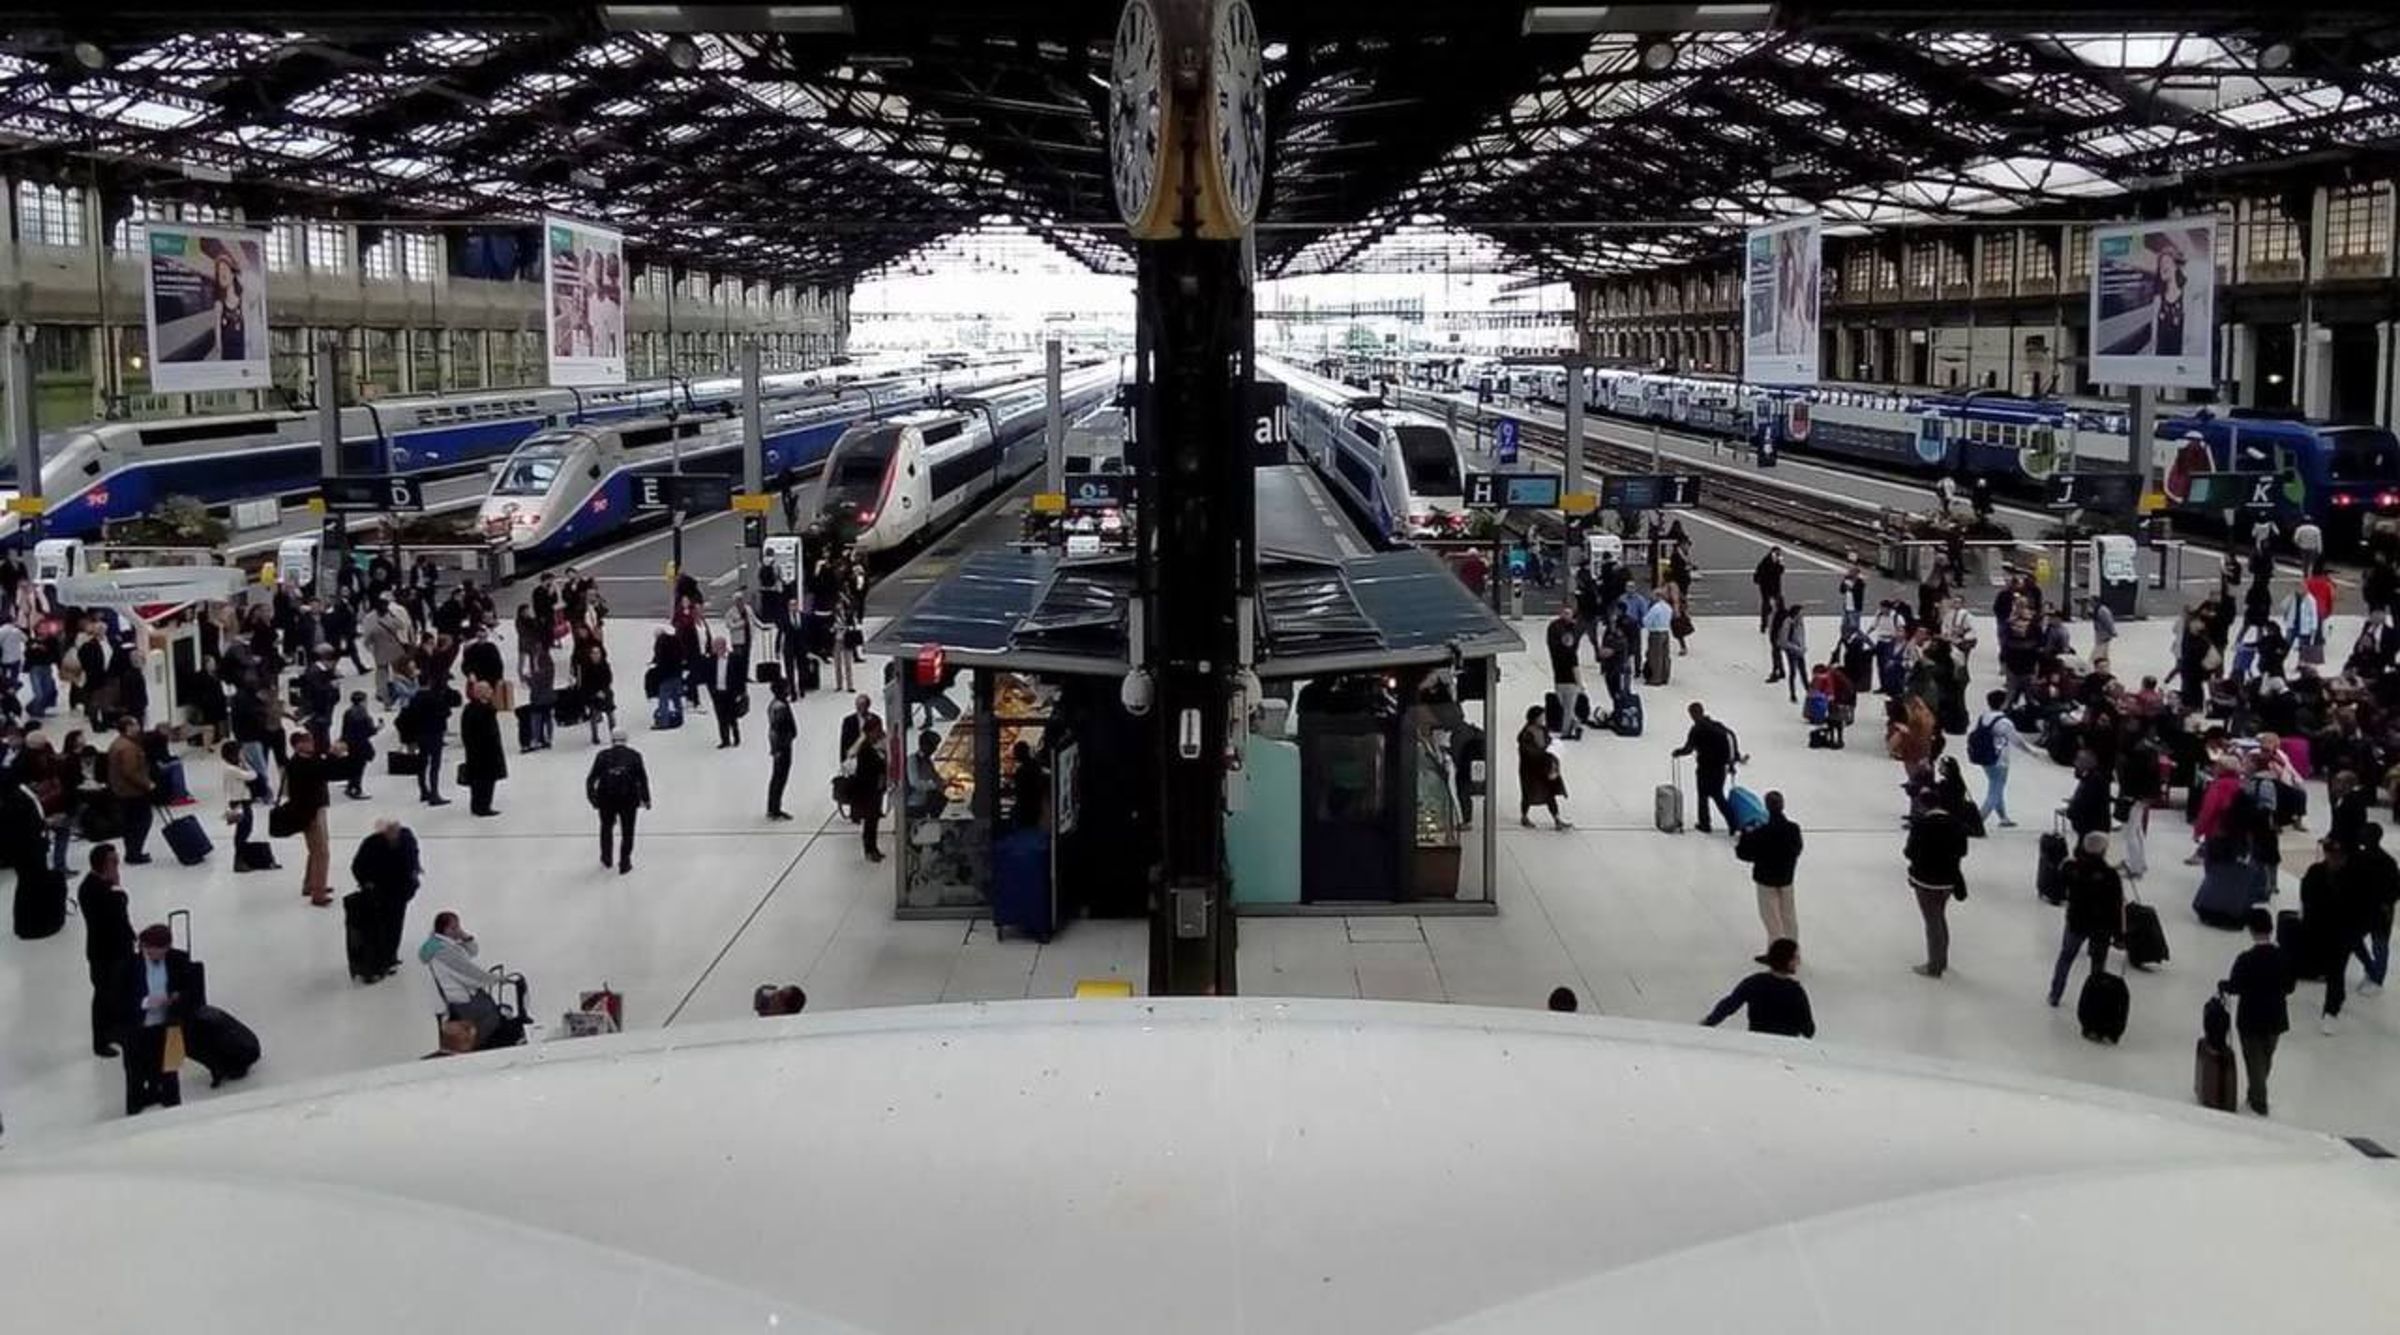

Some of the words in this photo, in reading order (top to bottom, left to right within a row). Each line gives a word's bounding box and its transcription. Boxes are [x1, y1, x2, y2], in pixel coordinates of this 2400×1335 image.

[1503, 423, 1514, 445] 9
[391, 487, 410, 505] D
[644, 485, 660, 504] E
[1474, 483, 1492, 503] H
[2057, 484, 2073, 503] J
[2253, 483, 2272, 503] K
